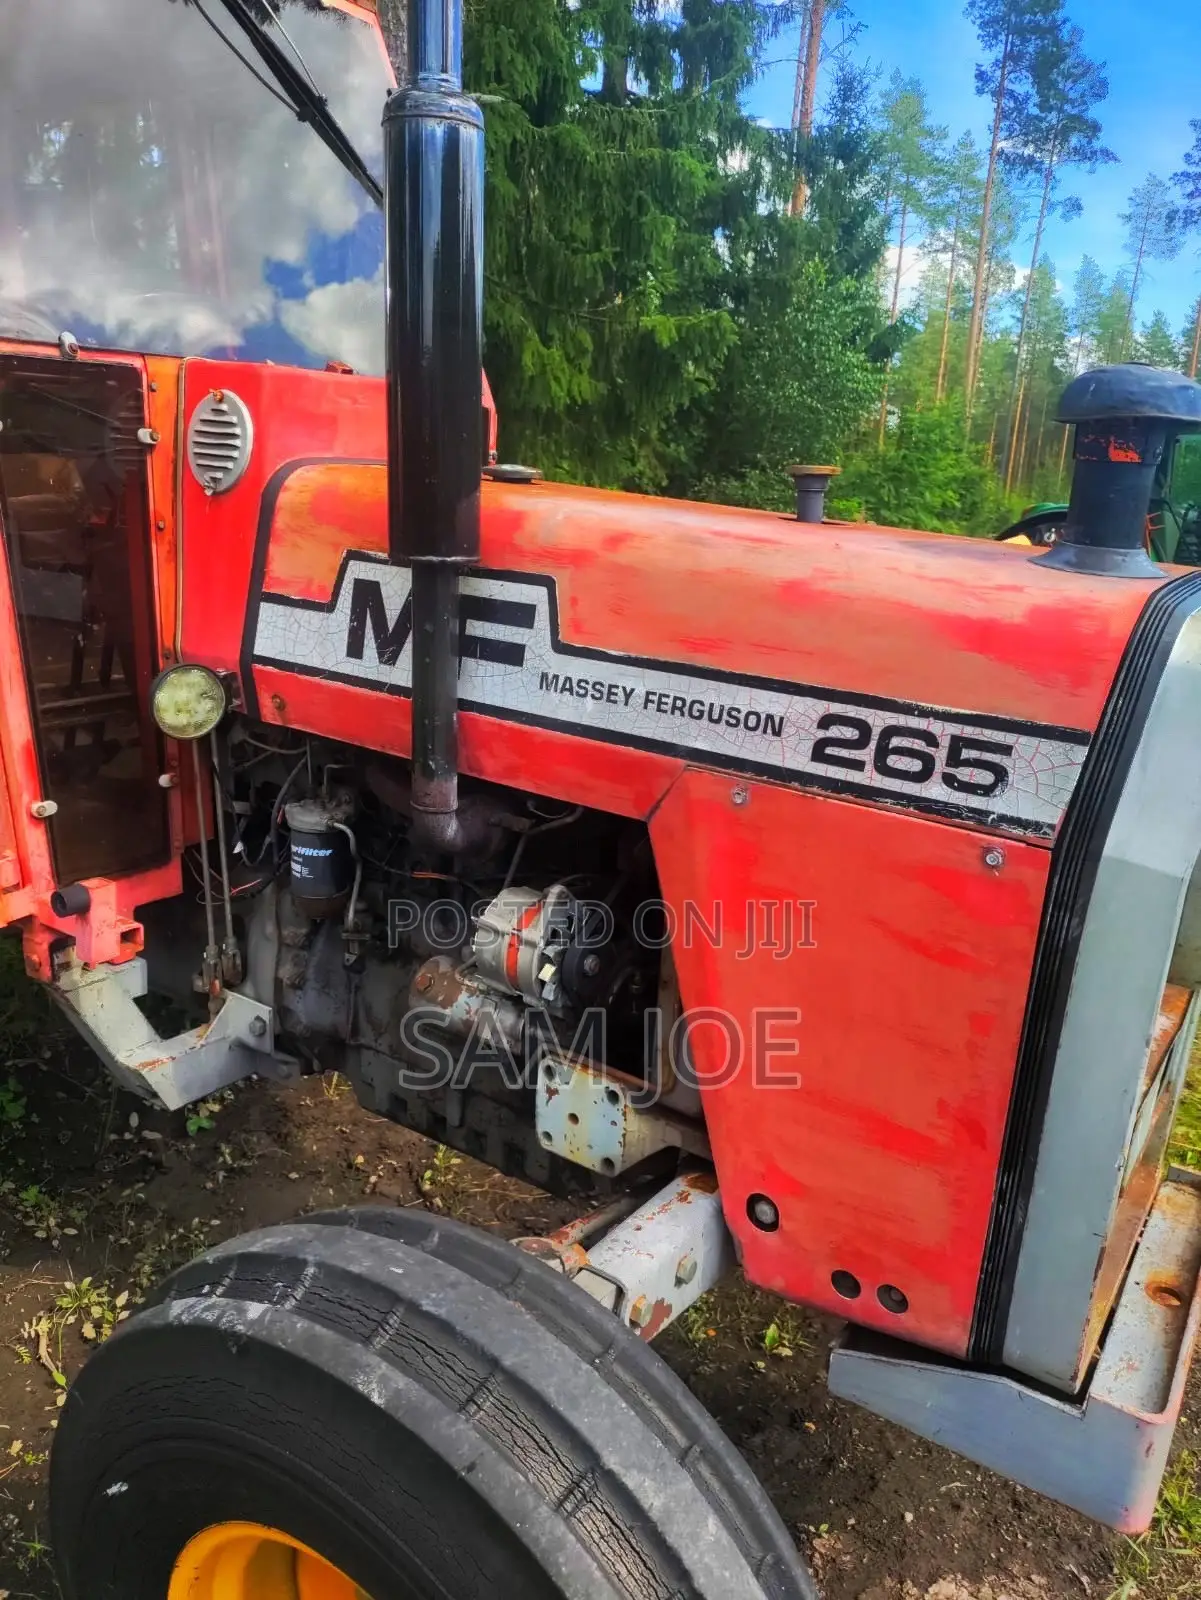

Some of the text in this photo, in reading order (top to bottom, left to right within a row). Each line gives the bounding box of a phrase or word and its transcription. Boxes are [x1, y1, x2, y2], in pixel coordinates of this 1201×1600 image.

[539, 671, 784, 737] MASSEY FERGUSON
[810, 713, 1012, 797] 265
